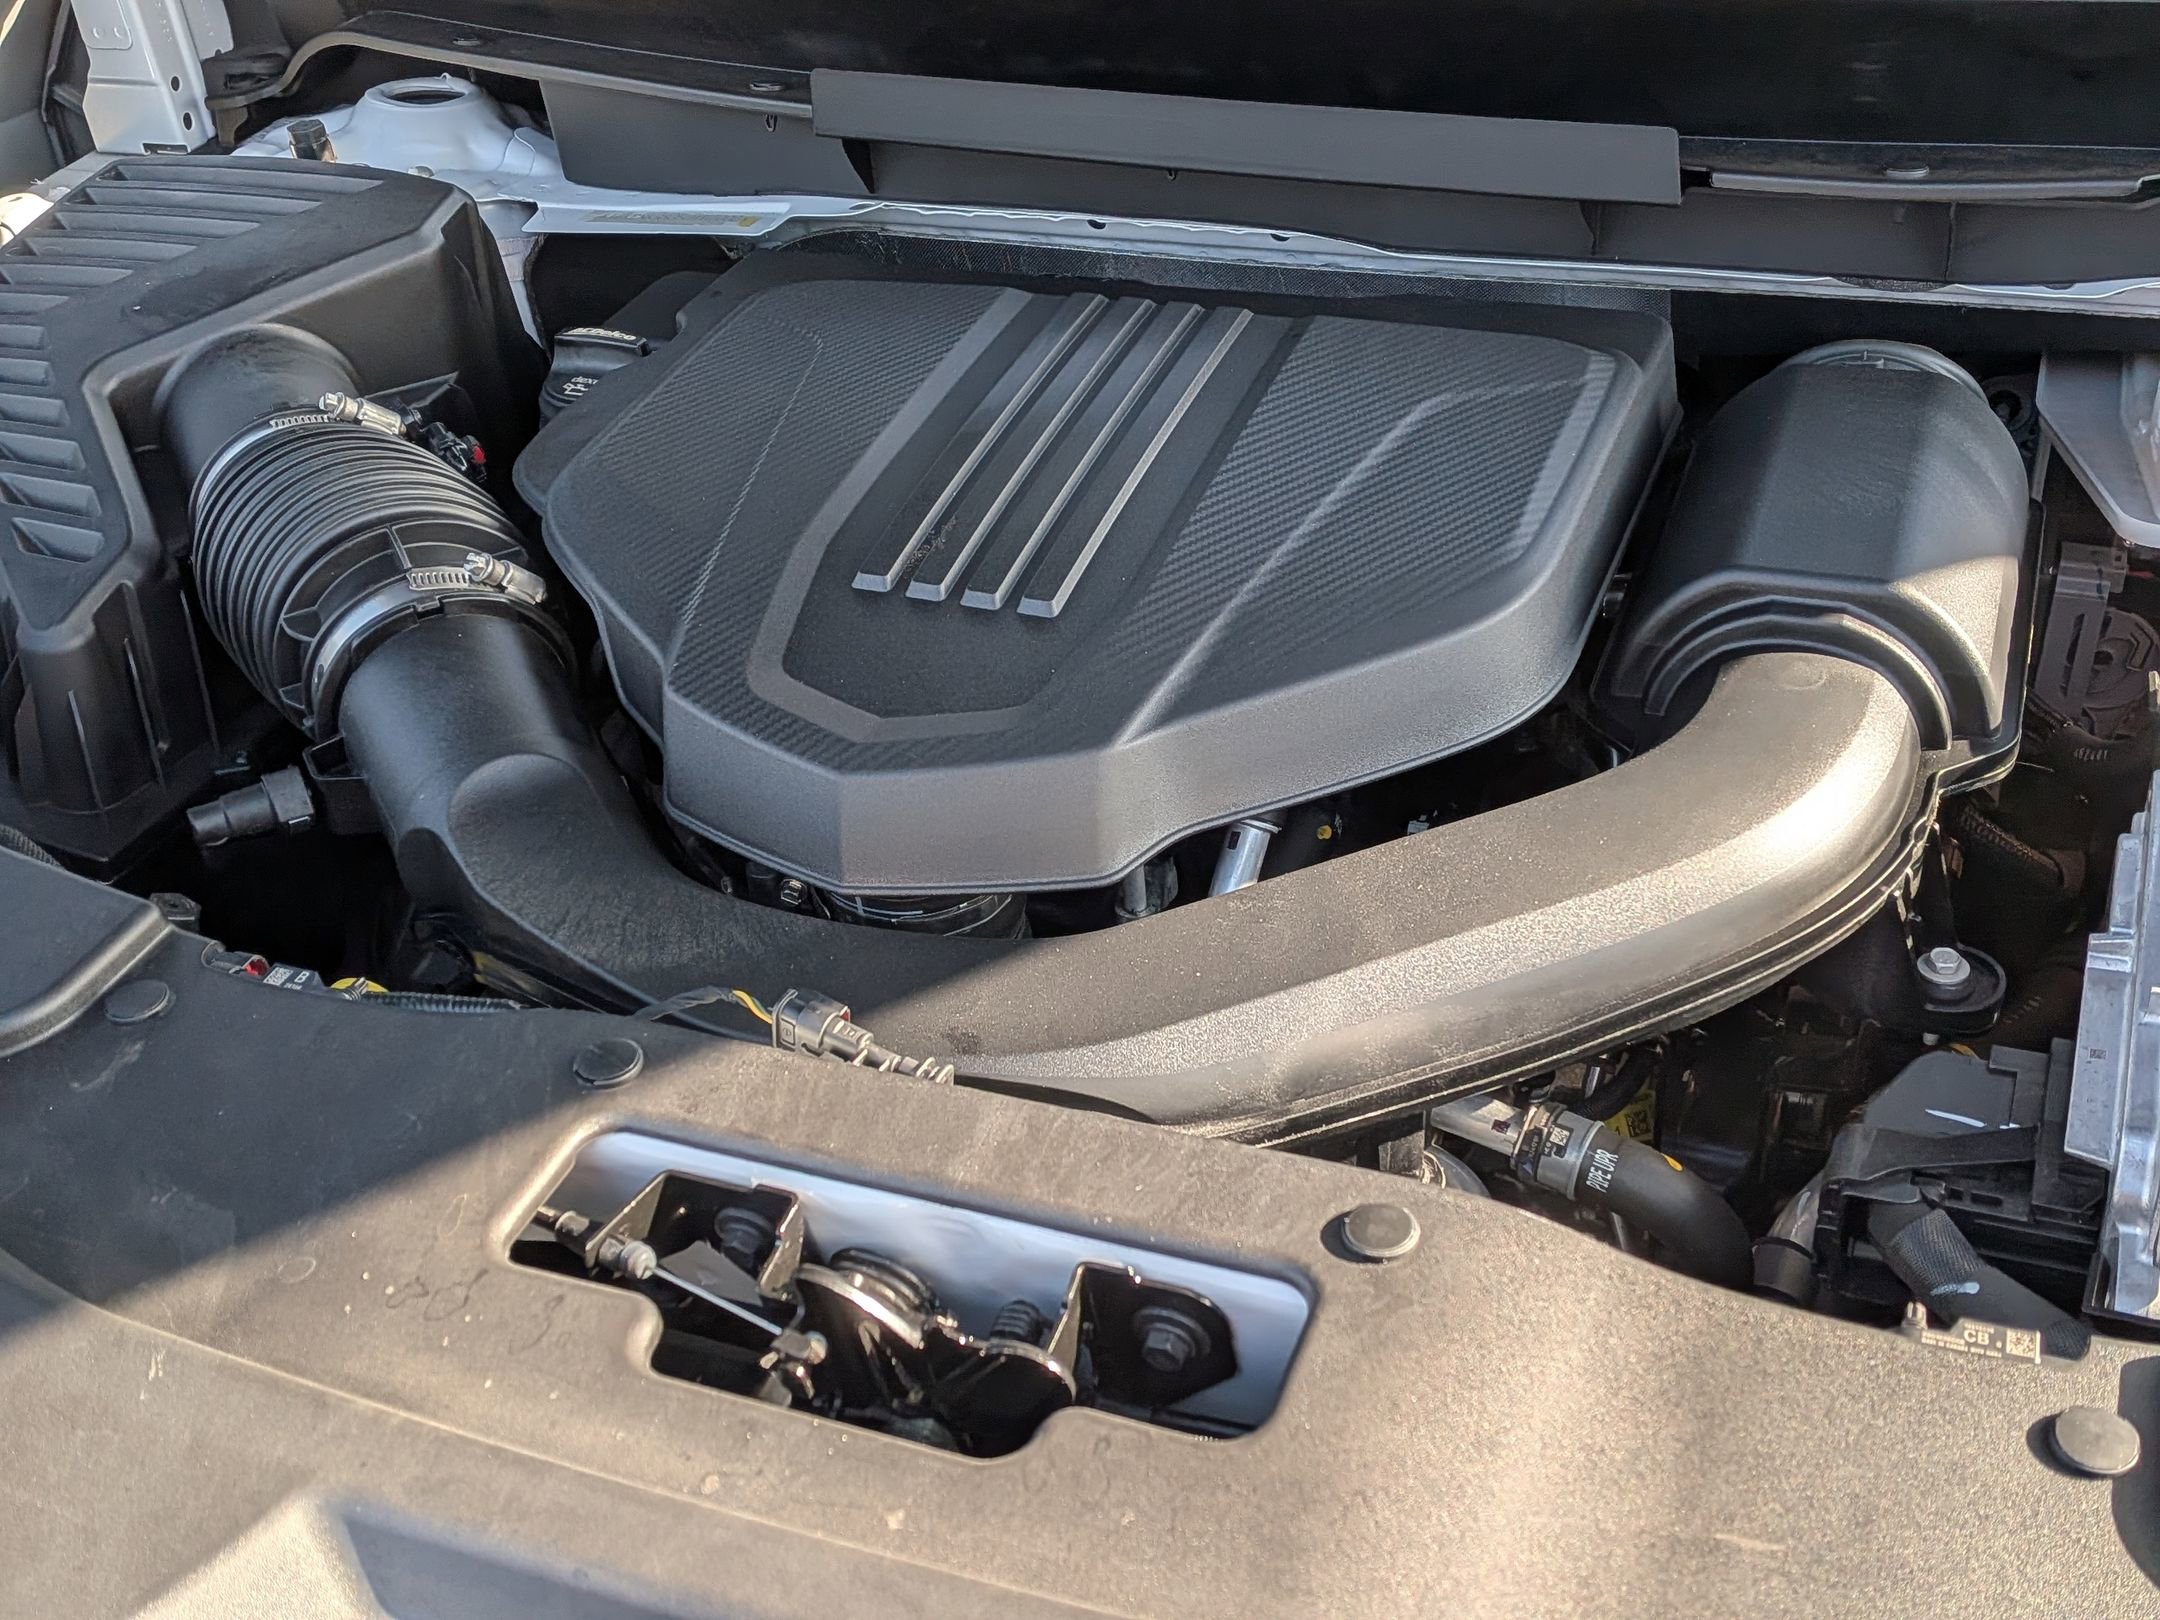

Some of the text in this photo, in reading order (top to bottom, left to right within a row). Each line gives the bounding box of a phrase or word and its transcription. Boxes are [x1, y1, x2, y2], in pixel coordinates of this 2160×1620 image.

[294, 971, 310, 983] B
[1586, 1148, 1619, 1193] PIPE UPR
[1963, 1328, 1990, 1345] CB
